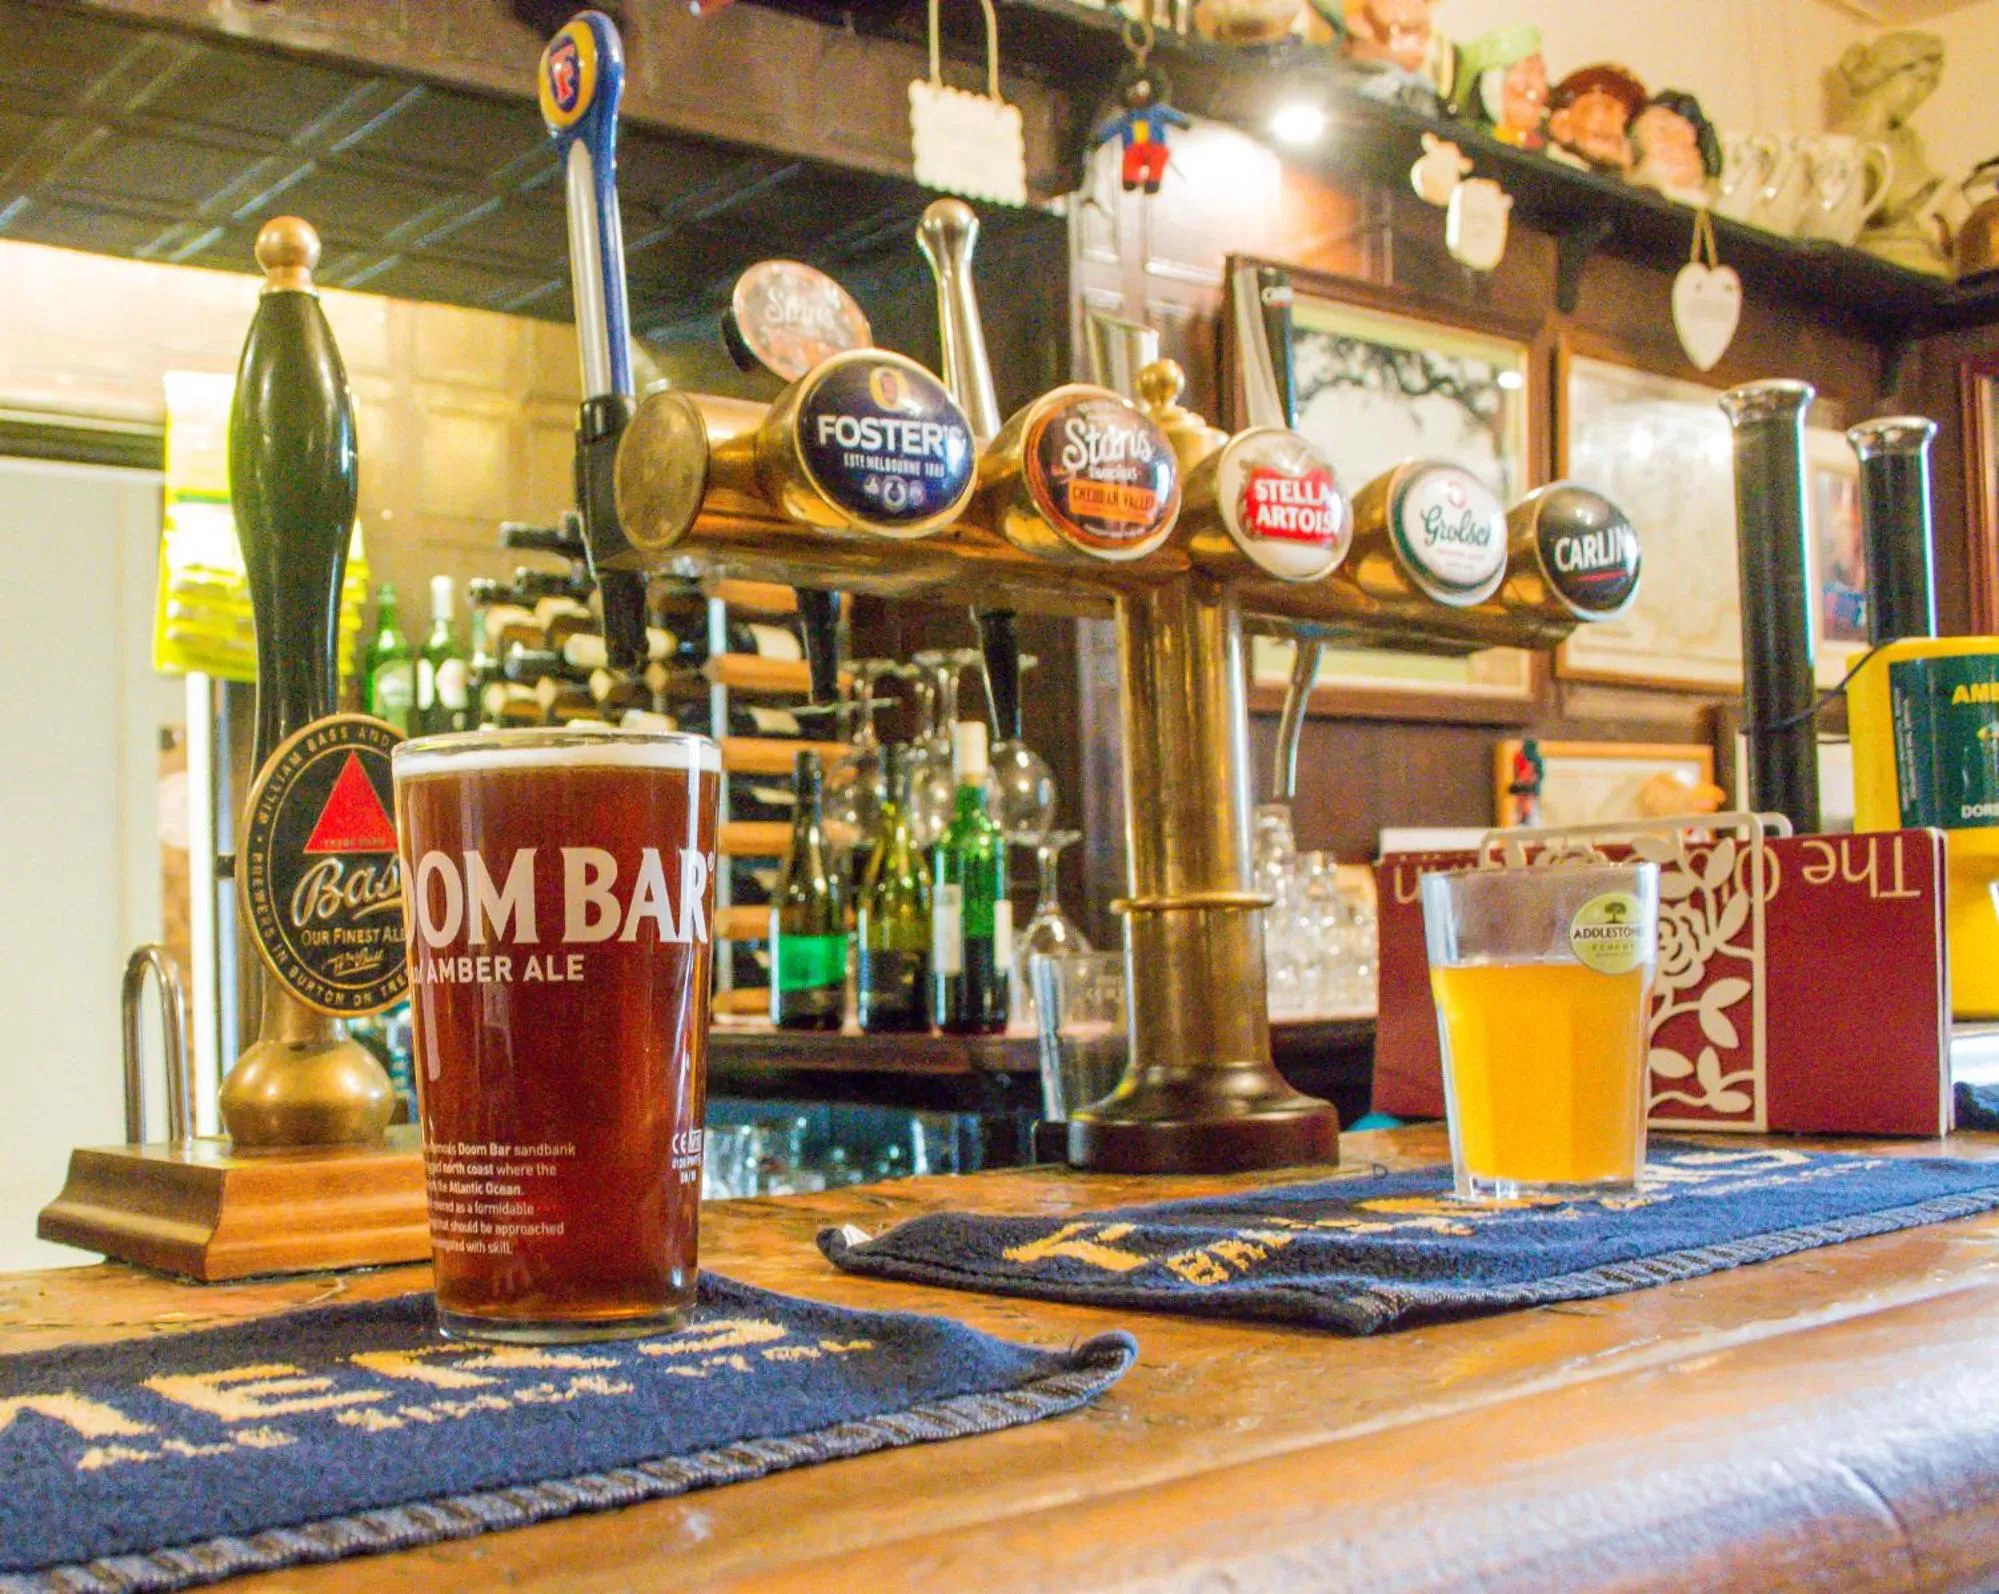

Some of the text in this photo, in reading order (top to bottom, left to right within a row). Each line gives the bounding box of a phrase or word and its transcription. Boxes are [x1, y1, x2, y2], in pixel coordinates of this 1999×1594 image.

[1555, 524, 1633, 573] CARLIN
[1801, 835, 1921, 899] The
[290, 856, 402, 928] Bas
[301, 929, 330, 946] OUR
[333, 926, 379, 944] FINEST
[426, 954, 514, 985] AMBER
[522, 953, 586, 983] ALE
[458, 1142, 487, 1156] Doom
[489, 1141, 512, 1156] Bar
[513, 1142, 576, 1157] sandbank
[467, 1163, 495, 1176] coast
[496, 1164, 534, 1177] where
[536, 1163, 557, 1177] the
[449, 1181, 483, 1194] Atlantic
[474, 1201, 535, 1215] formidable
[480, 1221, 493, 1234] be
[495, 1222, 565, 1237] approached
